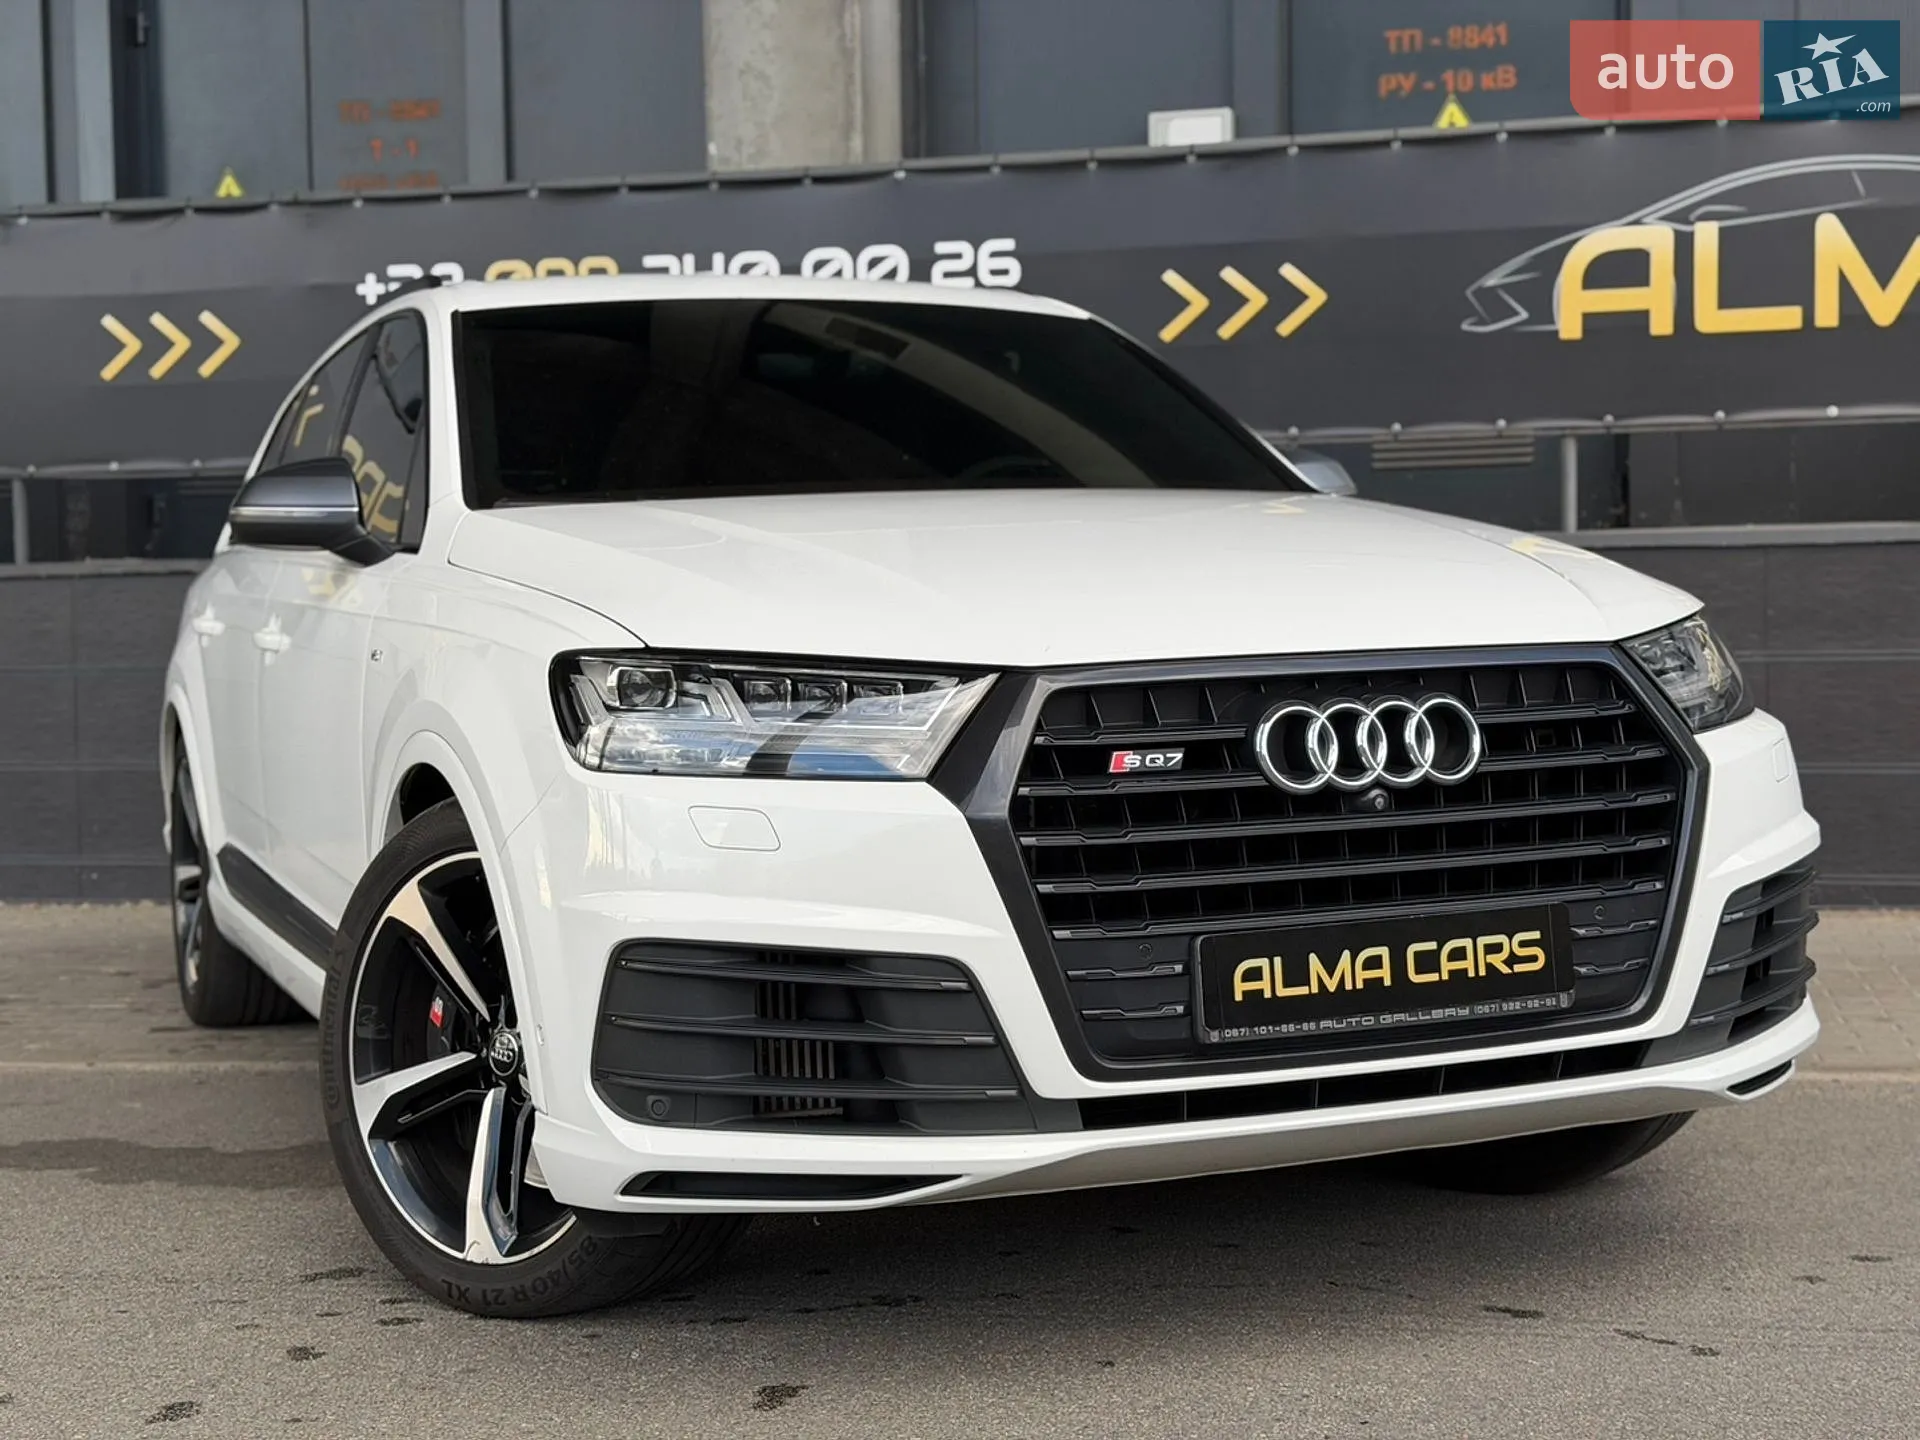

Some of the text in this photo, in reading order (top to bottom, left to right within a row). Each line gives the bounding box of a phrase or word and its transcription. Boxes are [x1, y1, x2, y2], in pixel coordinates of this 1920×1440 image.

[930, 238, 1022, 288] 26
[1233, 930, 1546, 1002] ALMA CARS
[1320, 1015, 1375, 1030] AUTO
[1380, 1005, 1470, 1024] GALLERY
